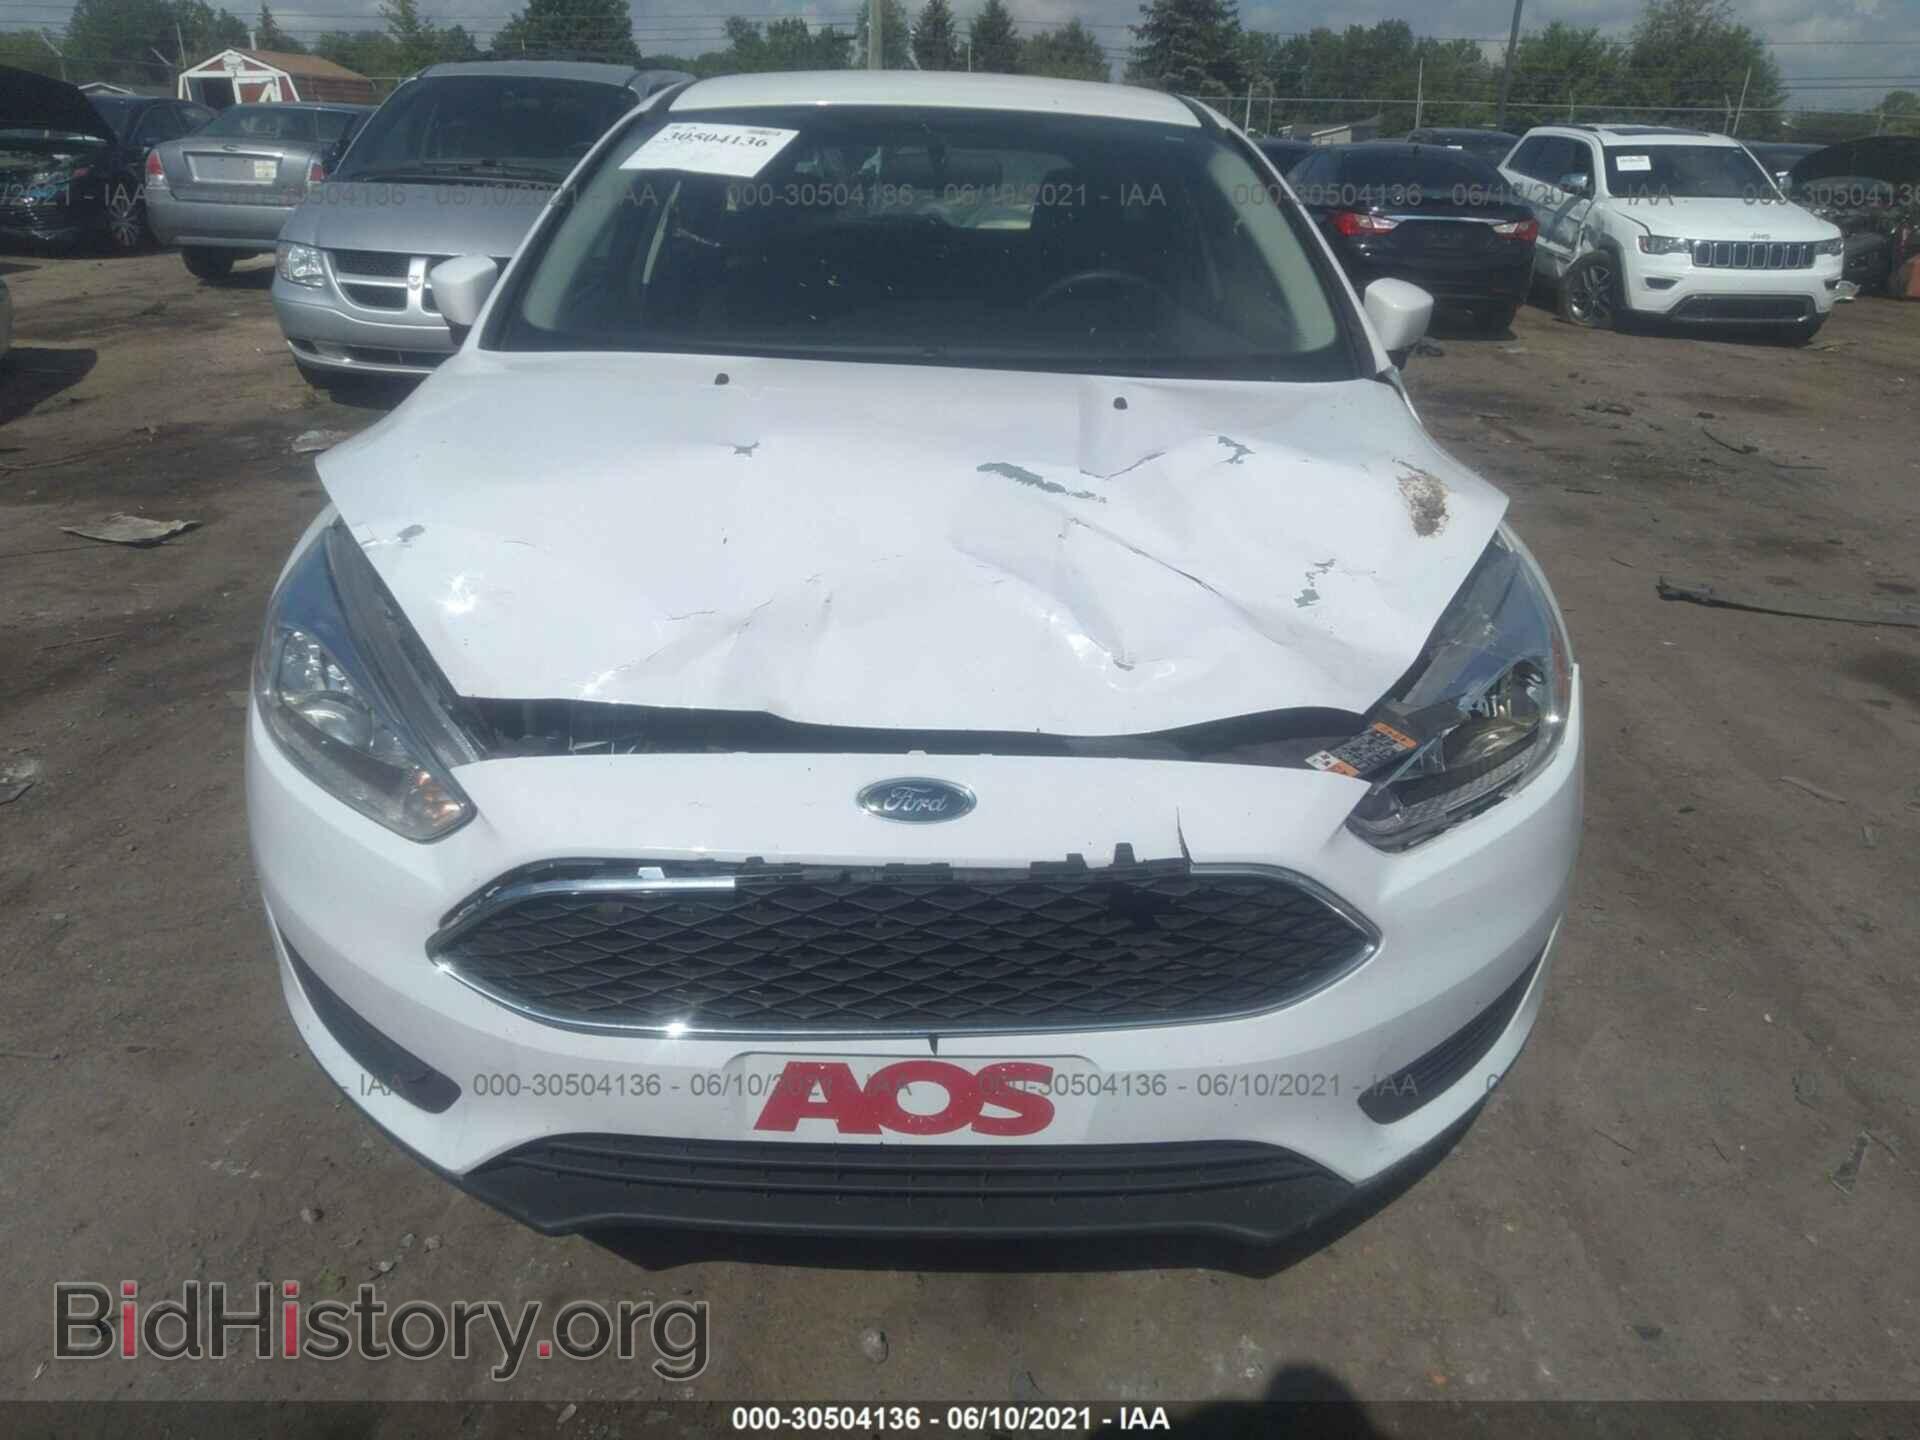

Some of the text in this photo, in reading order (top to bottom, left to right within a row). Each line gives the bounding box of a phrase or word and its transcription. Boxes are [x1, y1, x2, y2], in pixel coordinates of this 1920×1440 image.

[663, 130, 769, 149] 30504136
[883, 786, 949, 812] Ford
[753, 1059, 1056, 1137] AOS
